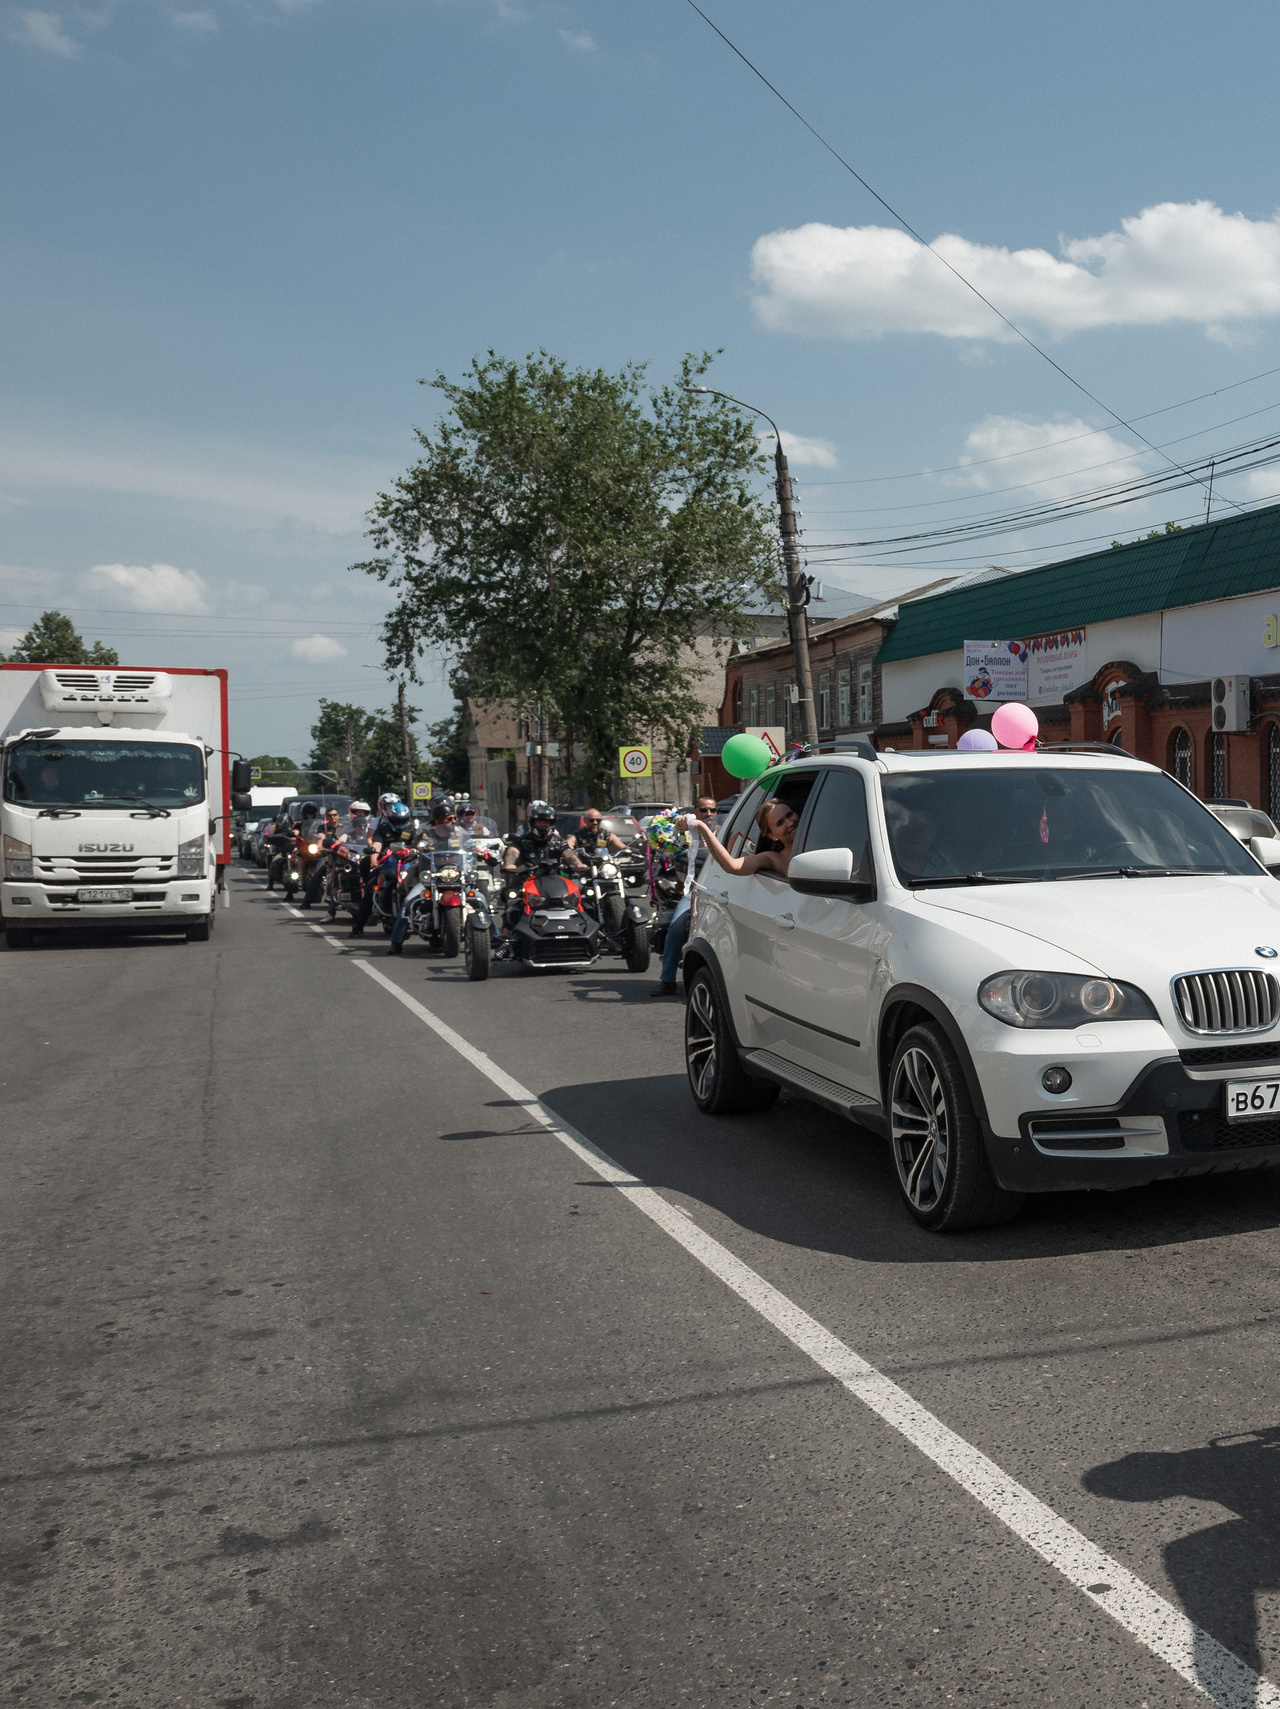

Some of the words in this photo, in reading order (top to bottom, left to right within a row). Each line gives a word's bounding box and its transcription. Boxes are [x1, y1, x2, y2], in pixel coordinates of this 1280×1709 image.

[966, 655, 980, 667] Дон
[984, 655, 1011, 667] баллон
[628, 756, 643, 766] 40
[78, 843, 135, 853] ISUZU
